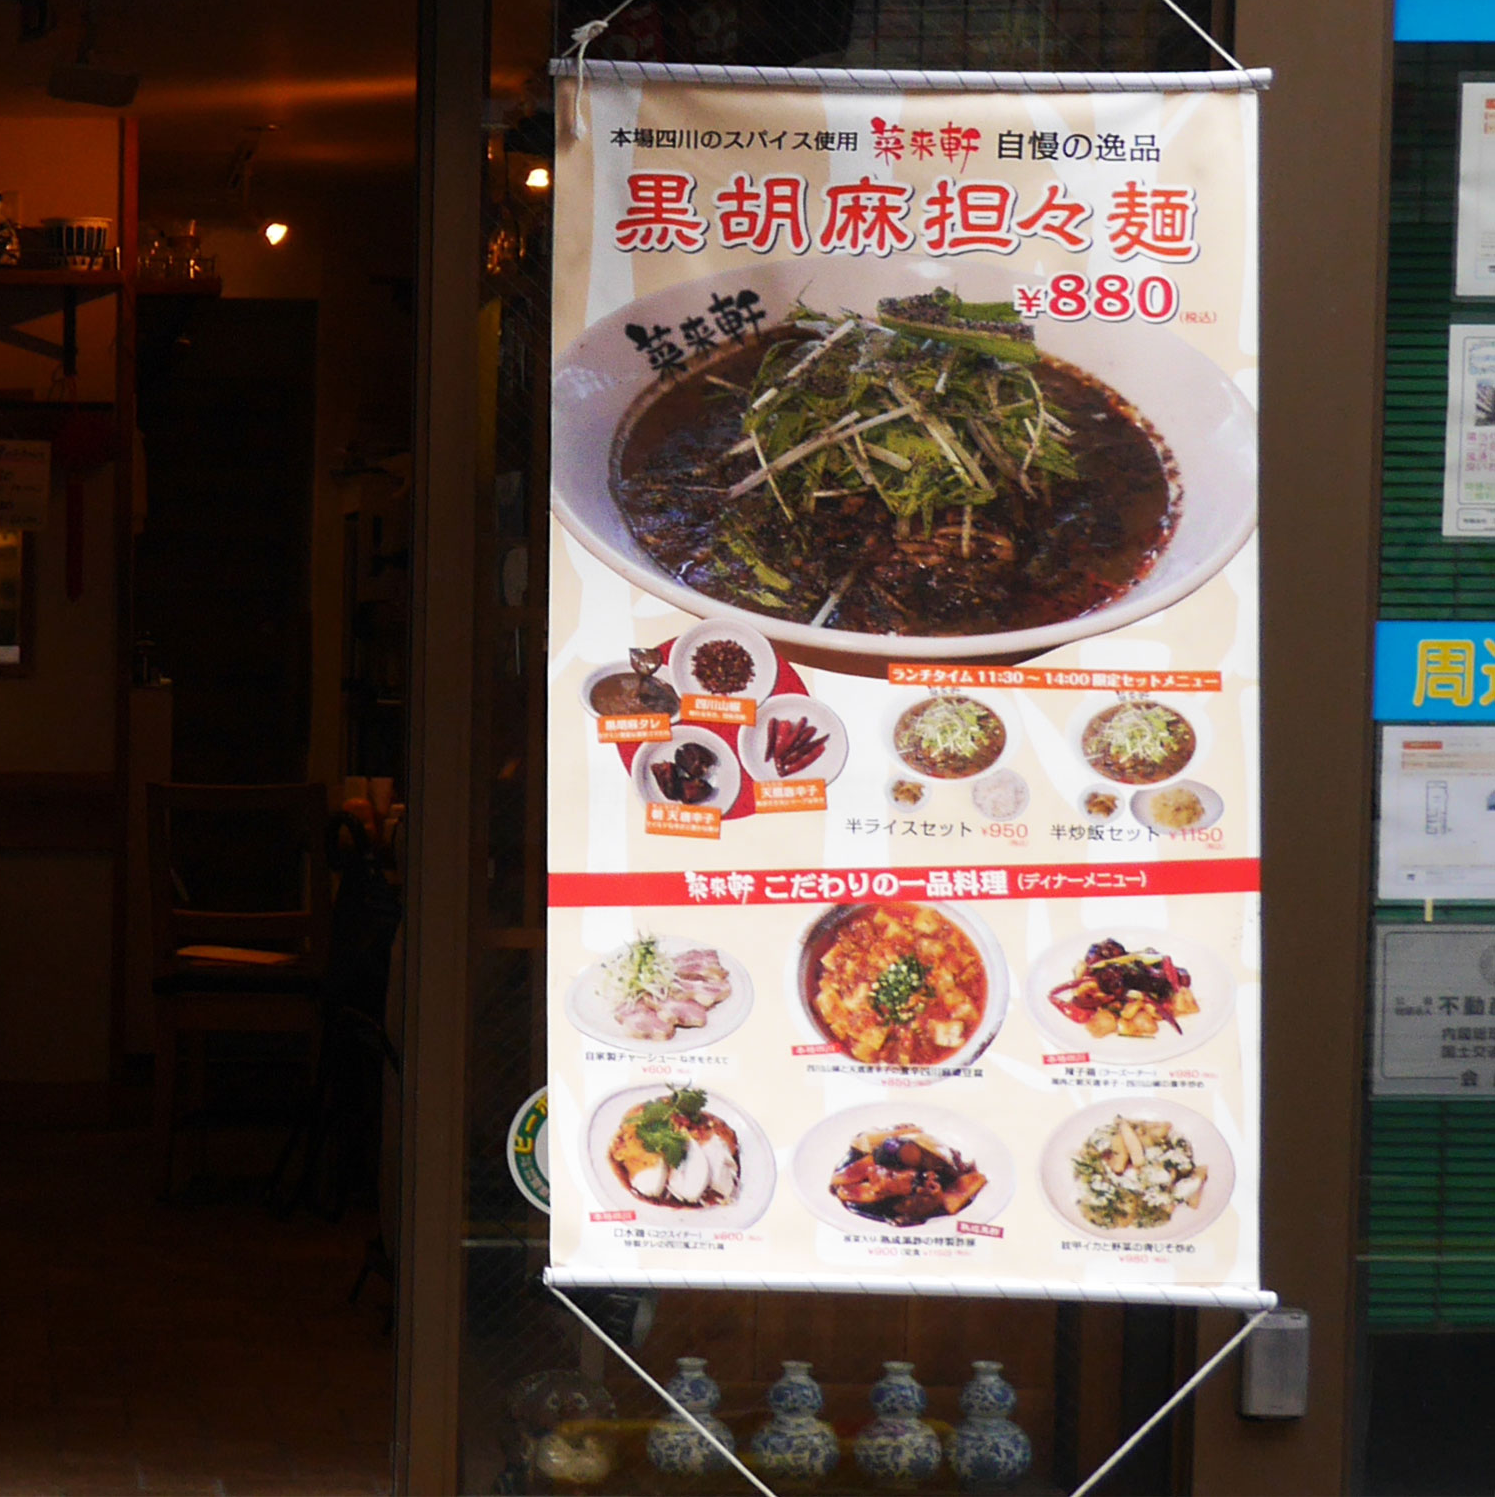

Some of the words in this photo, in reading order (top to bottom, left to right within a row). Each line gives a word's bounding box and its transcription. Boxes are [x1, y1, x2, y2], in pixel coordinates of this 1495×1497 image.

[610, 126, 859, 154] 本場四川のスパイス使用
[870, 116, 982, 174] 菜来軒
[995, 128, 1162, 163] 自慢の逸品
[613, 172, 1197, 260] 黒胡麻担々麺
[978, 670, 1023, 685] 11:30
[1045, 671, 1091, 686] 14:00
[845, 818, 972, 837] 半ライスセット
[1050, 823, 1161, 842] 半炒飯セット
[765, 871, 1008, 901] こだわりの一品料理
[1017, 870, 1147, 891] (ディナーメニュー)
